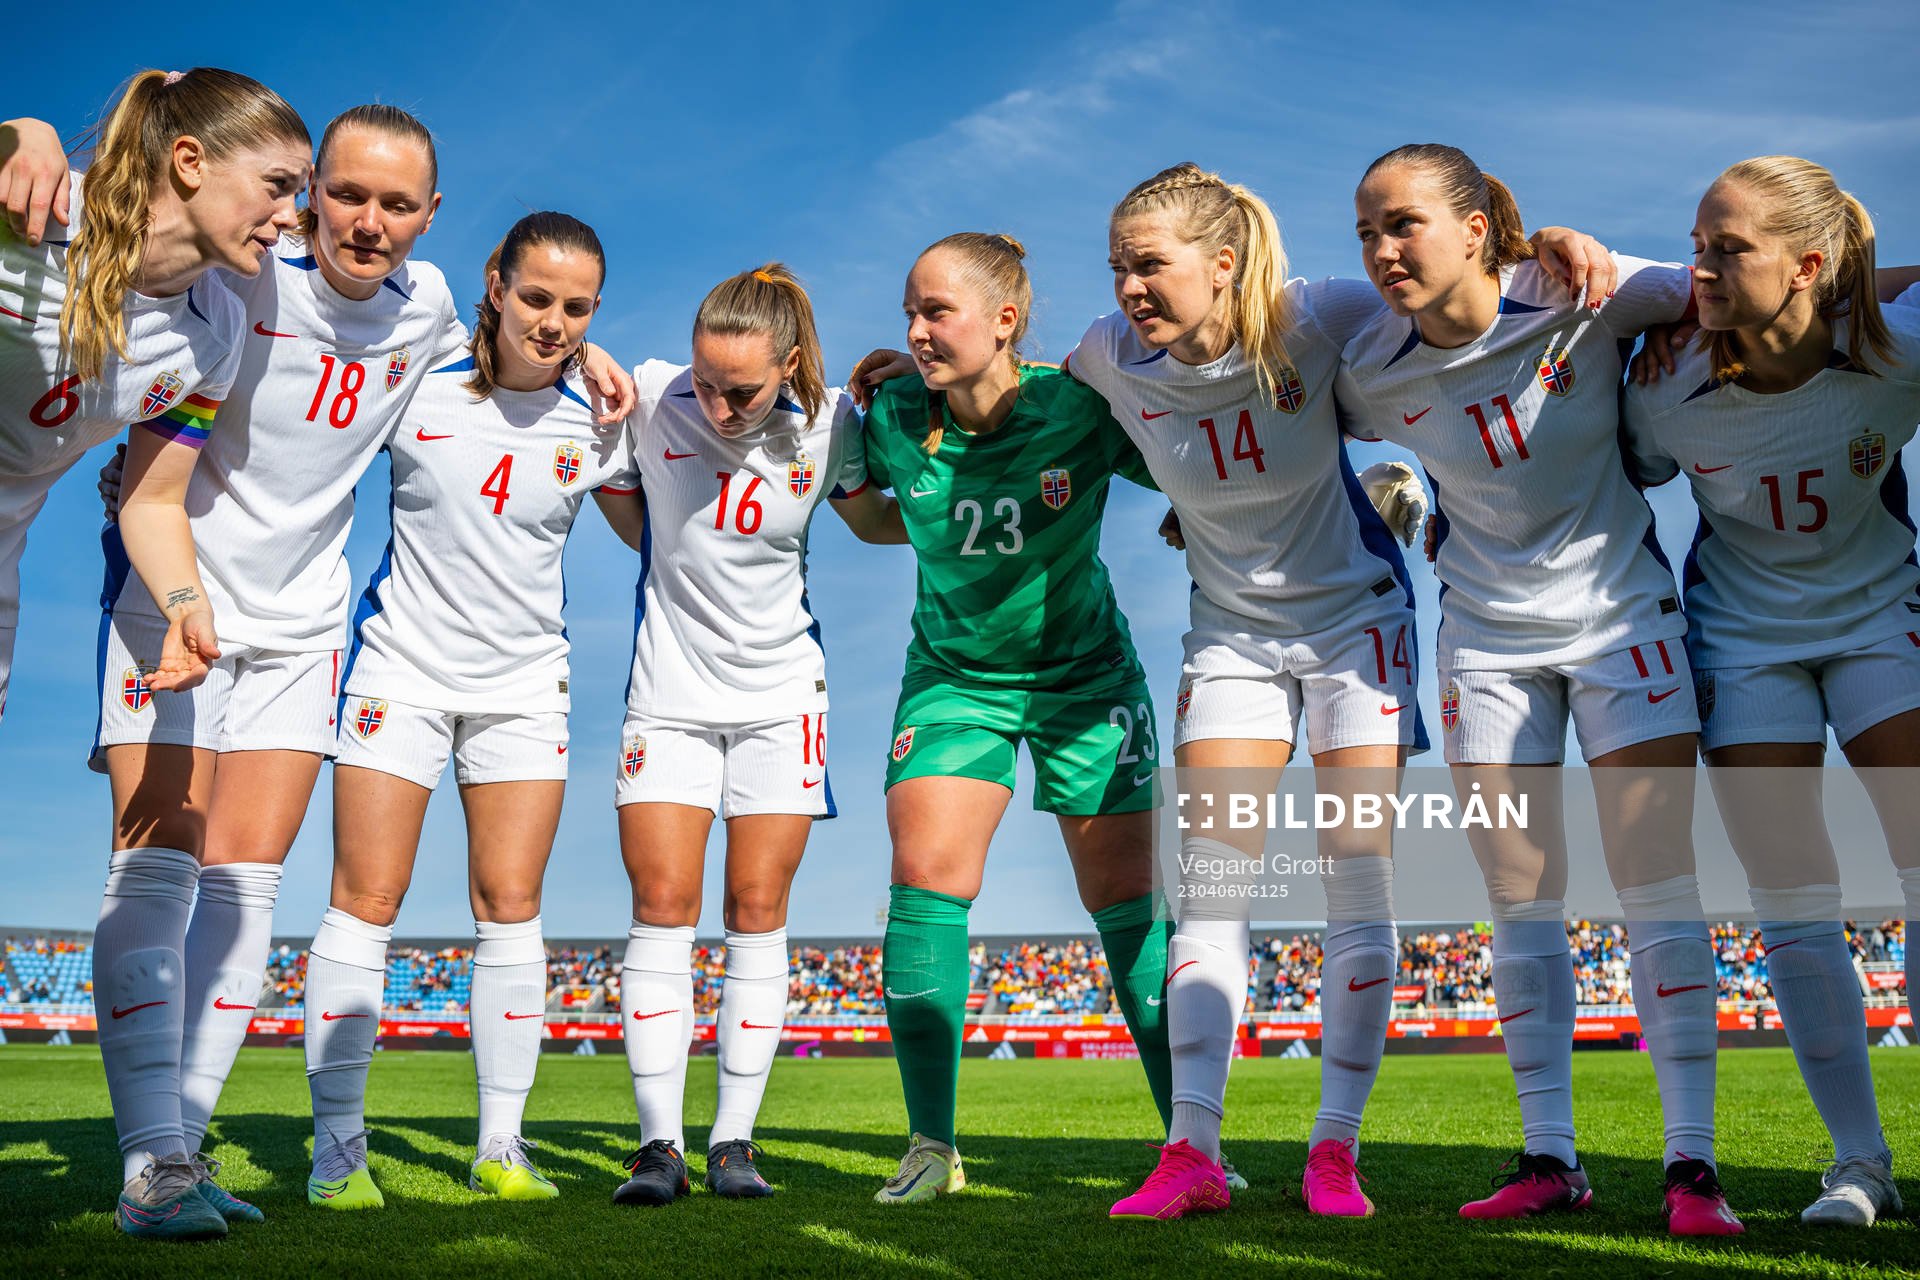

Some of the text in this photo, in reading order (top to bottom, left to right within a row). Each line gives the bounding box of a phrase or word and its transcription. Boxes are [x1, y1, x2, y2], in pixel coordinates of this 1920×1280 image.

[29, 374, 81, 428] 6
[305, 354, 365, 429] 18
[1198, 409, 1265, 480] 14
[1464, 394, 1530, 469] 11
[480, 454, 514, 515] 4
[714, 471, 763, 535] 16
[1760, 468, 1828, 533] 15
[955, 498, 1023, 555] 23
[1363, 624, 1412, 685] 14
[1629, 640, 1674, 679] 11
[800, 713, 825, 767] 16
[1109, 702, 1155, 765] 23
